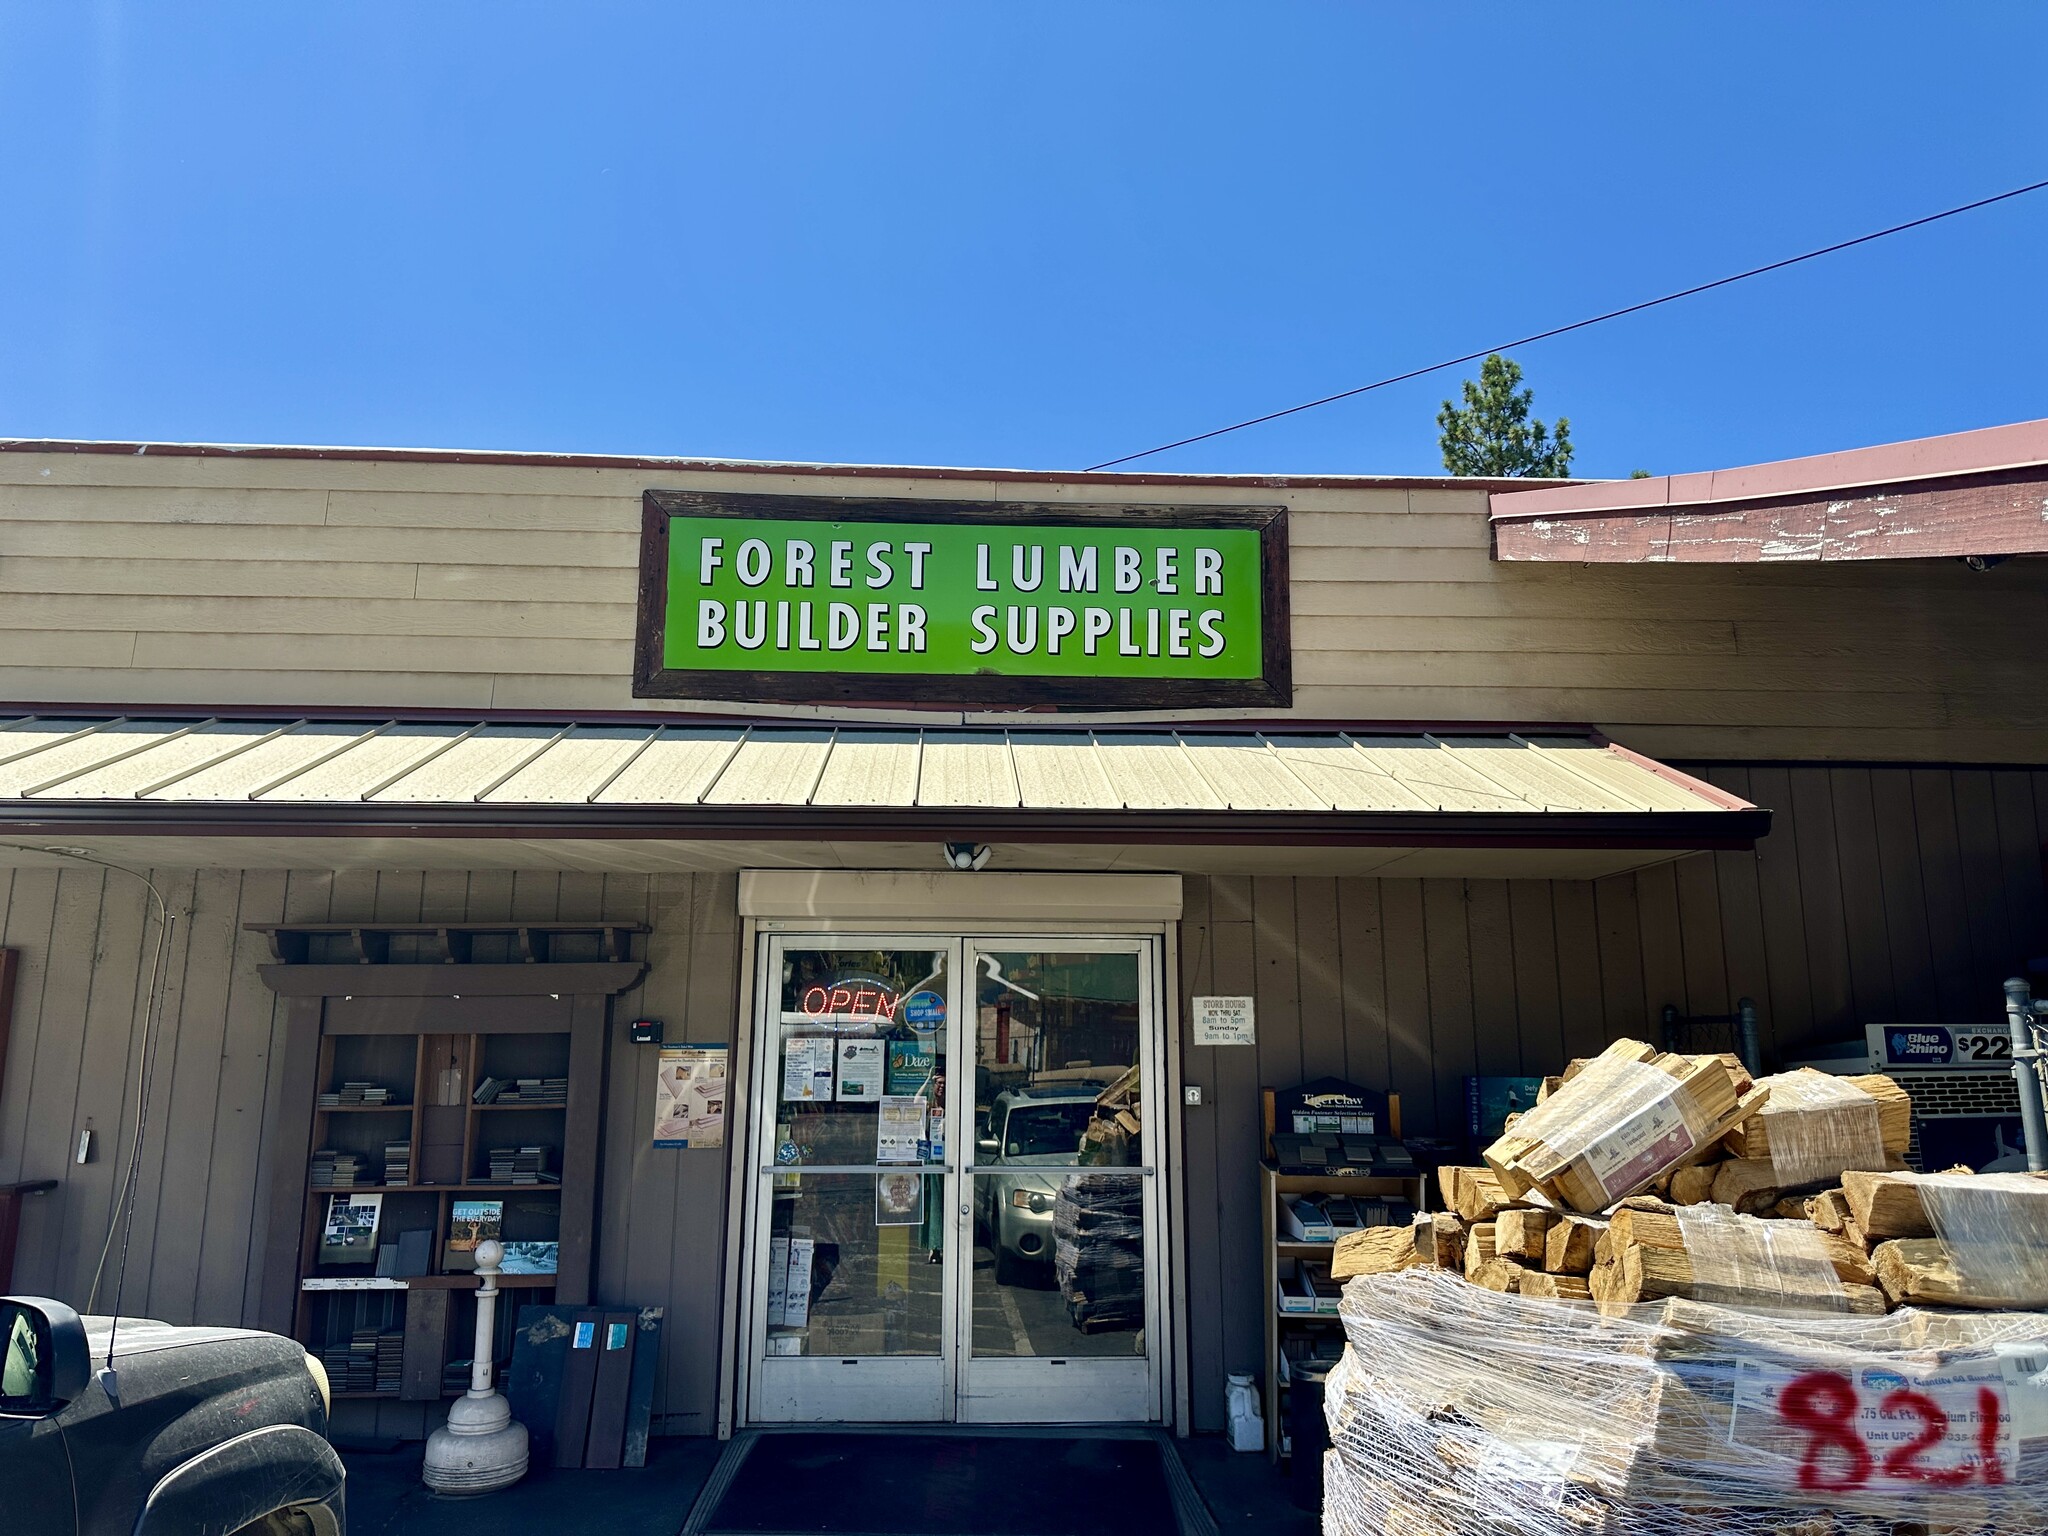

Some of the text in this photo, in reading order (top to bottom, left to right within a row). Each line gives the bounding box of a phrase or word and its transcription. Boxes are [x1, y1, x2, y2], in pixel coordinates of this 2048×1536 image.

[698, 537, 1224, 596] FOREST LUMBER
[697, 599, 1227, 659] BUILDER SUPPLIES
[803, 986, 901, 1023] OPEN
[1203, 1000, 1246, 1009] STORE HOURS
[1202, 1016, 1216, 1024] 8am
[1231, 1017, 1245, 1025] 5pm
[1908, 1033, 1939, 1043] Blue
[1906, 1043, 1947, 1054] Rhino
[1958, 1035, 2013, 1060] $22
[904, 1053, 930, 1067] Daze
[452, 1208, 501, 1216] GET OUTSIDE
[1913, 1375, 1952, 1387] Quantity
[1861, 1408, 1877, 1419] .75
[1900, 1410, 1915, 1420] Ft.
[1780, 1370, 2005, 1492] 821
[1866, 1431, 1888, 1440] Unit
[1892, 1431, 1914, 1440] UPC
